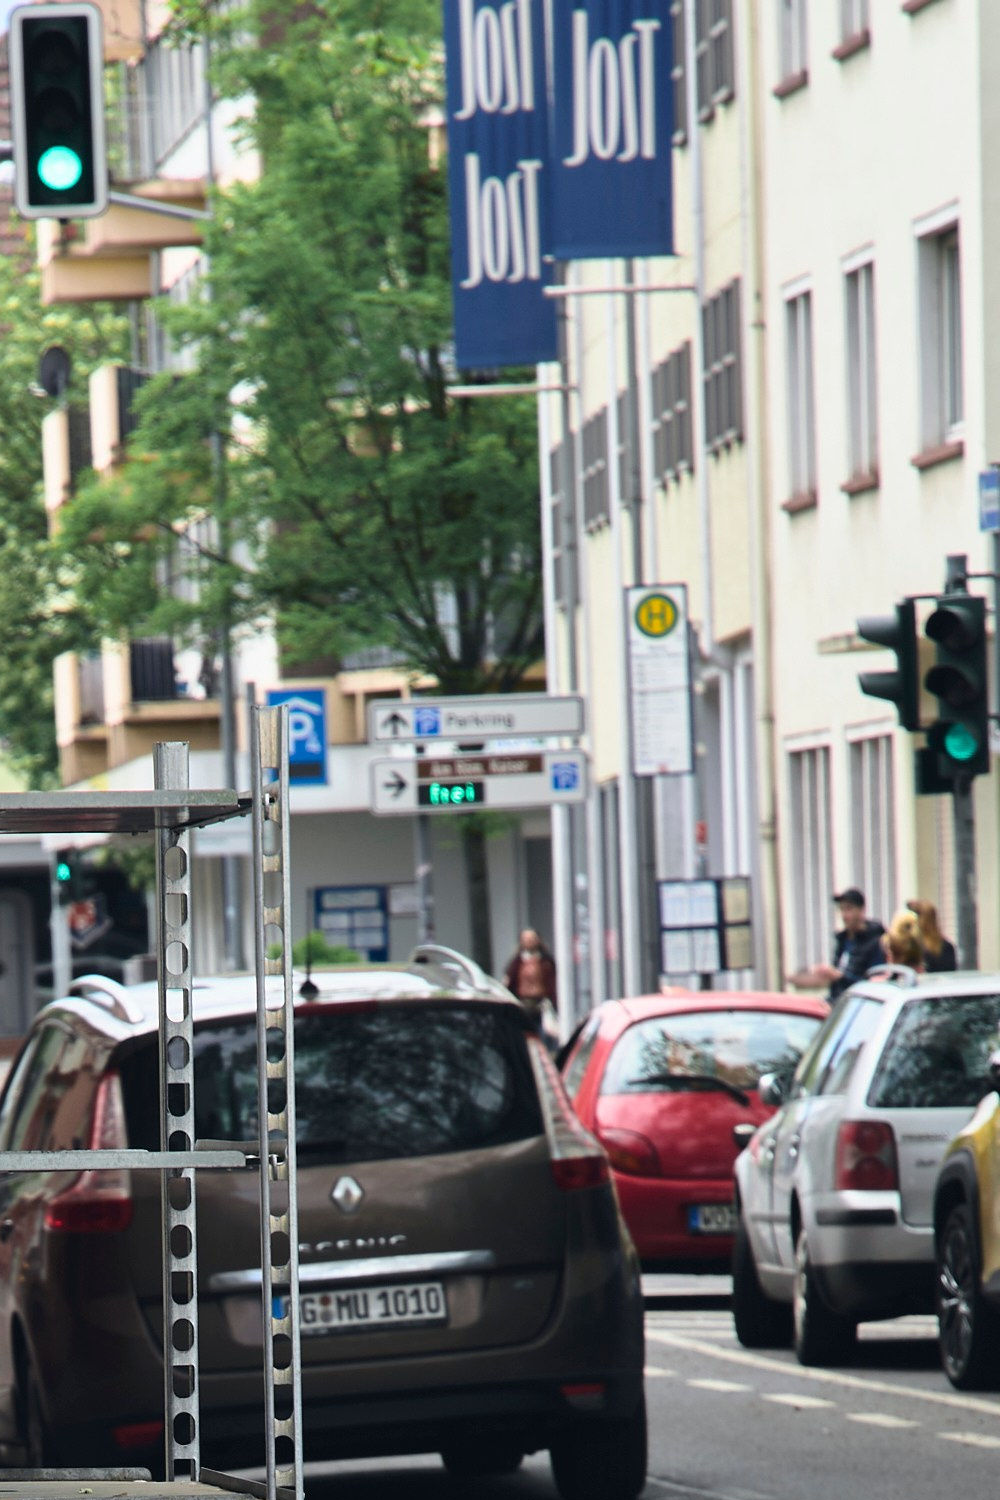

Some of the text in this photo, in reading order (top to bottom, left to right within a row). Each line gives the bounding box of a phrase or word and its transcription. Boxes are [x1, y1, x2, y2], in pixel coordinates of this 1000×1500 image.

[648, 603, 667, 627] H
[446, 712, 516, 728] Parkring
[429, 782, 475, 805] frei
[336, 1292, 370, 1321] MU
[378, 1284, 442, 1317] 1010
